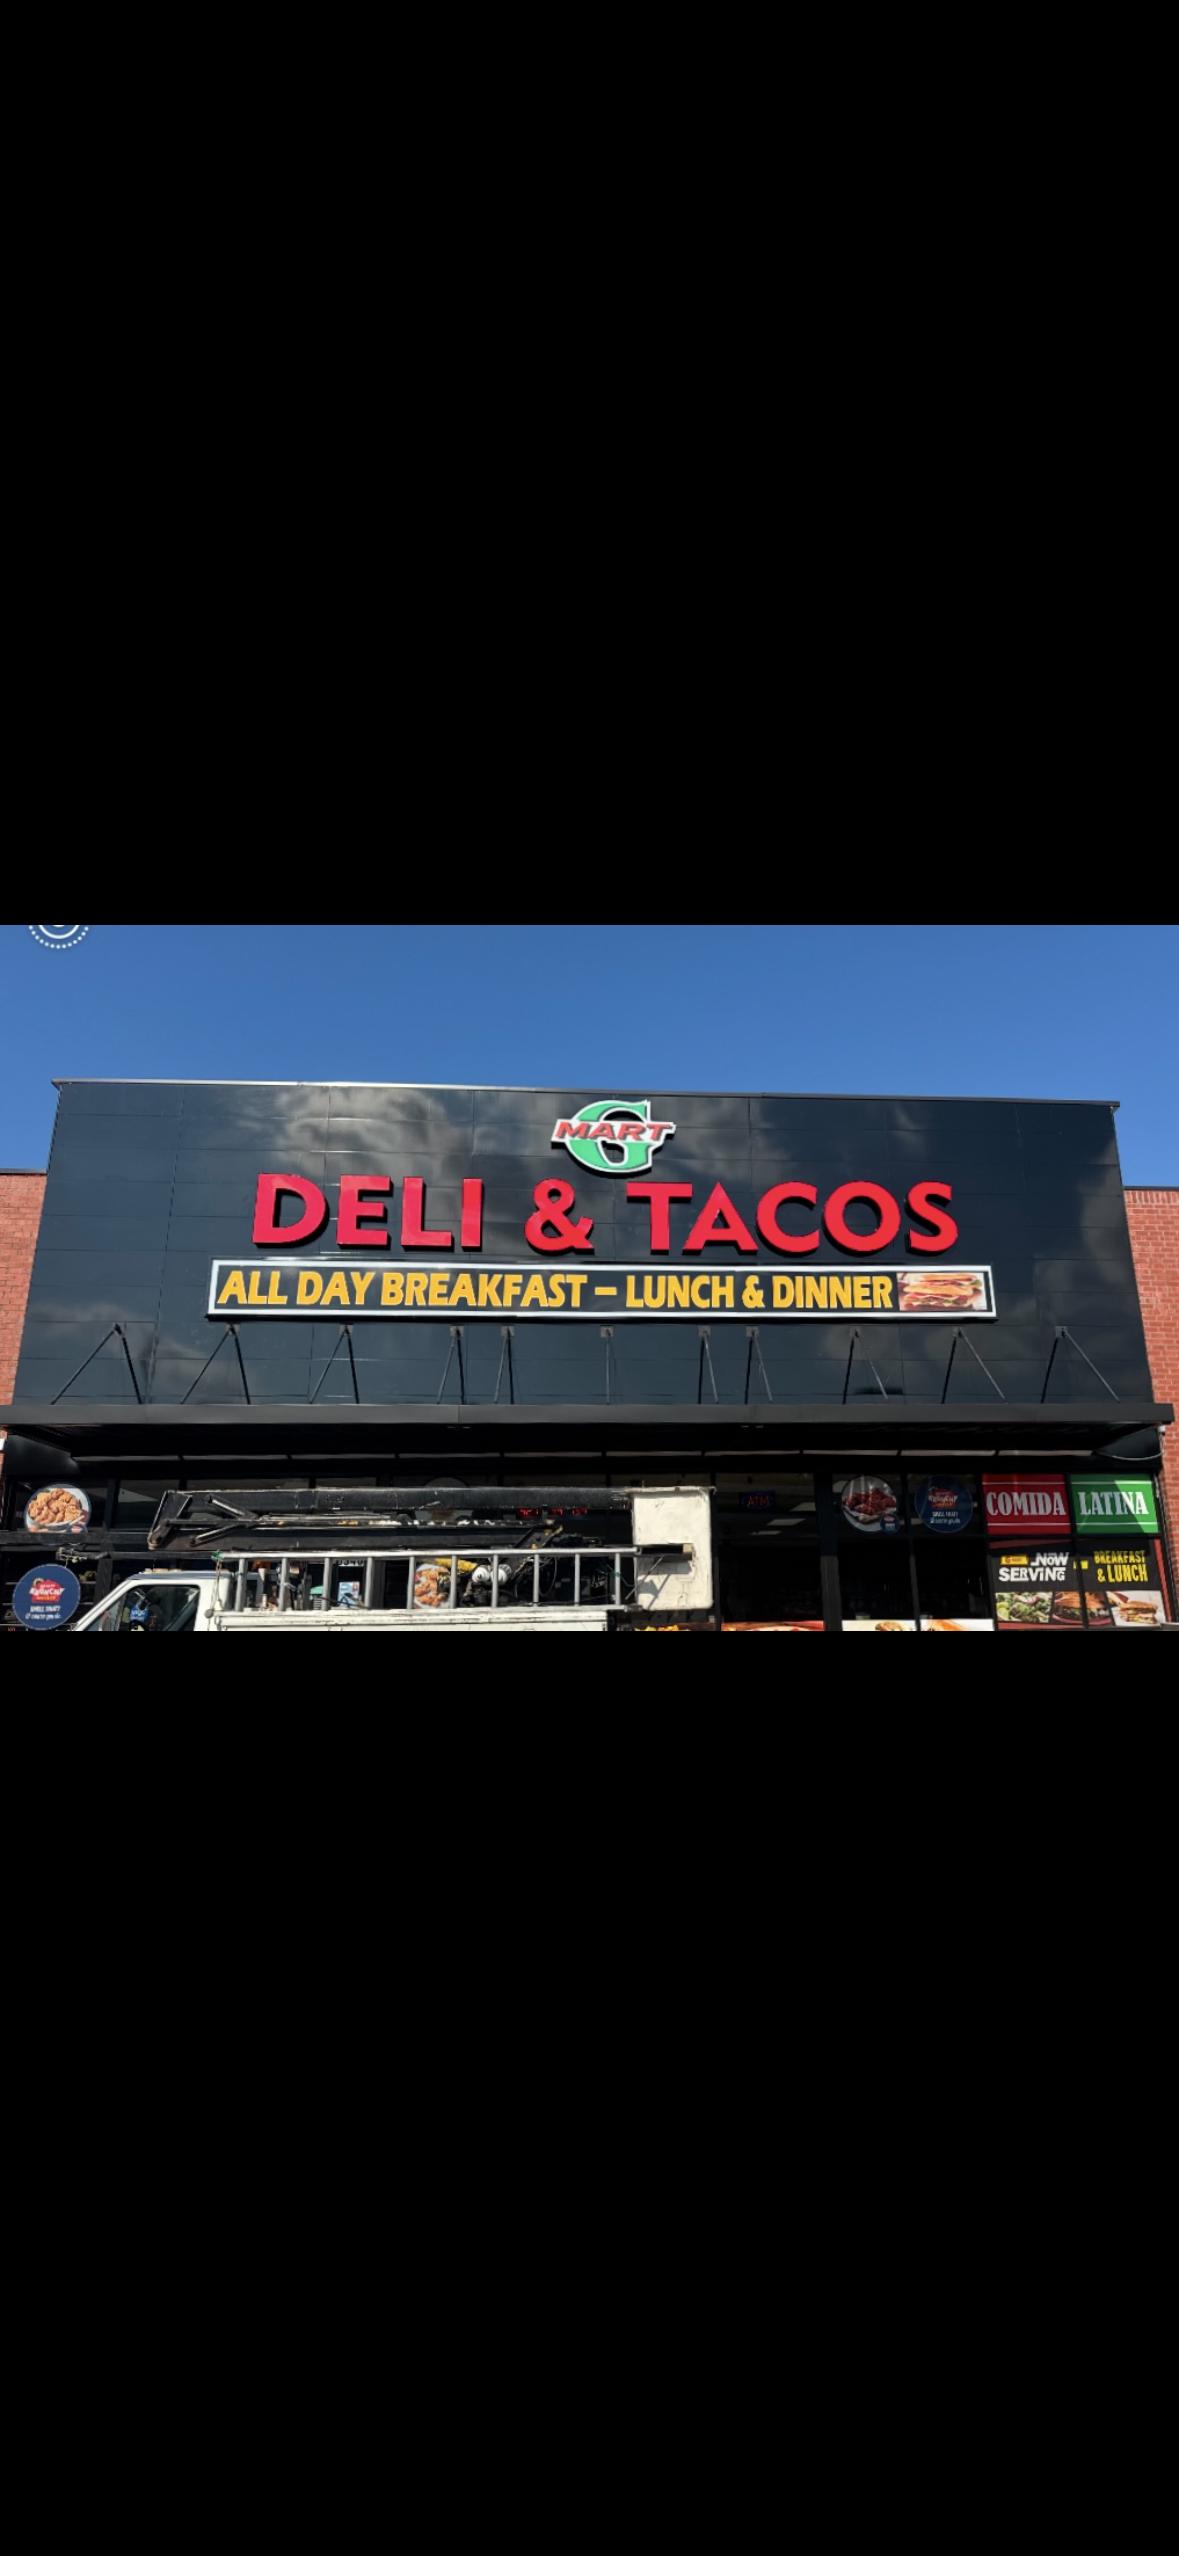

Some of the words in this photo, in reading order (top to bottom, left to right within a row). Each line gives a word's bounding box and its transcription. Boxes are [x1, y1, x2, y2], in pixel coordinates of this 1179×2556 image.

[556, 1120, 672, 1141] MART
[569, 1100, 651, 1172] G
[252, 1173, 483, 1247] DELI
[525, 1178, 594, 1251] &
[627, 1181, 958, 1253] TACOS
[217, 1271, 287, 1305] ALL
[297, 1272, 375, 1306] DAY
[381, 1272, 588, 1308] BREAKFAST
[625, 1275, 735, 1309] LUNCH
[742, 1275, 765, 1309] &
[772, 1275, 894, 1309] DINNER
[747, 1496, 770, 1507] ATM
[986, 1491, 1067, 1516] COMIDA
[1078, 1491, 1150, 1515] LATINA
[1093, 1550, 1147, 1565] BREAKFAST
[1097, 1568, 1107, 1582] &
[1107, 1564, 1148, 1582] LUNCH
